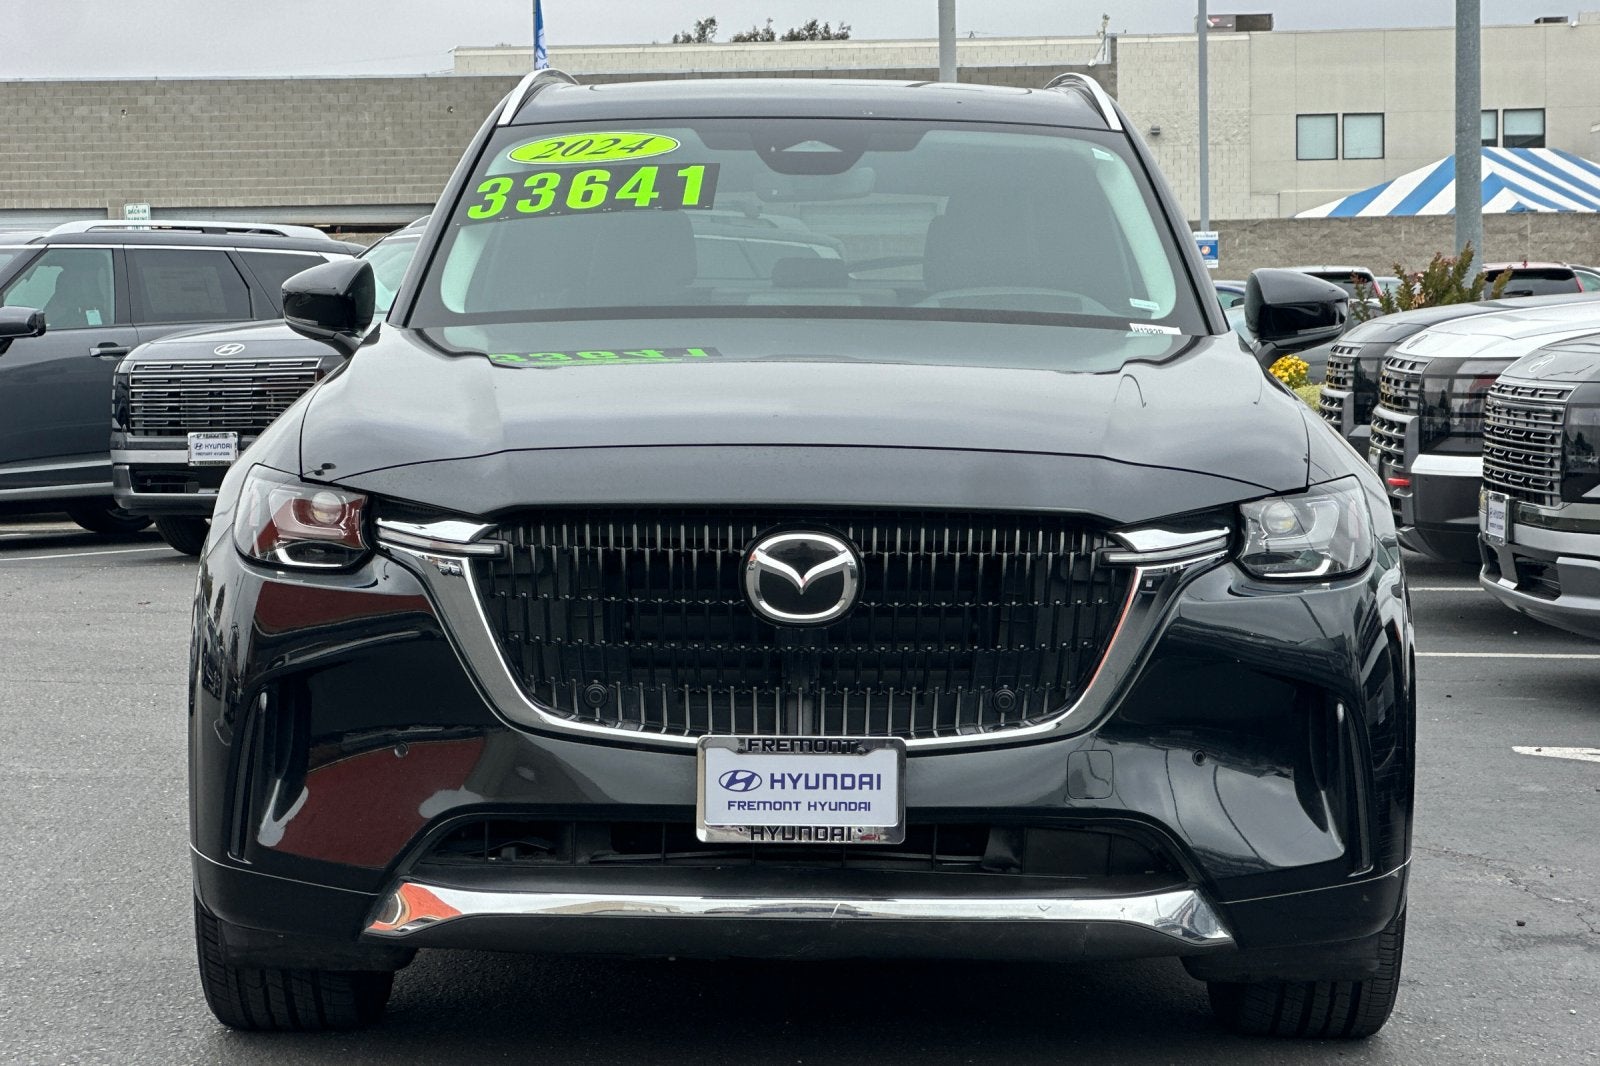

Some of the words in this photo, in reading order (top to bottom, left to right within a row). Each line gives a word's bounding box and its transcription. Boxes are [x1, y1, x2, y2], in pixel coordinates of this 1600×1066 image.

[530, 137, 657, 161] 2024
[467, 165, 706, 219] 33641
[204, 442, 233, 450] HYUNDAI
[748, 738, 857, 753] FREMONT
[769, 773, 882, 791] HYUNDAI
[727, 800, 802, 811] FREMONT
[807, 801, 871, 812] HYUNDAI
[750, 825, 852, 841] HYUNDAI
